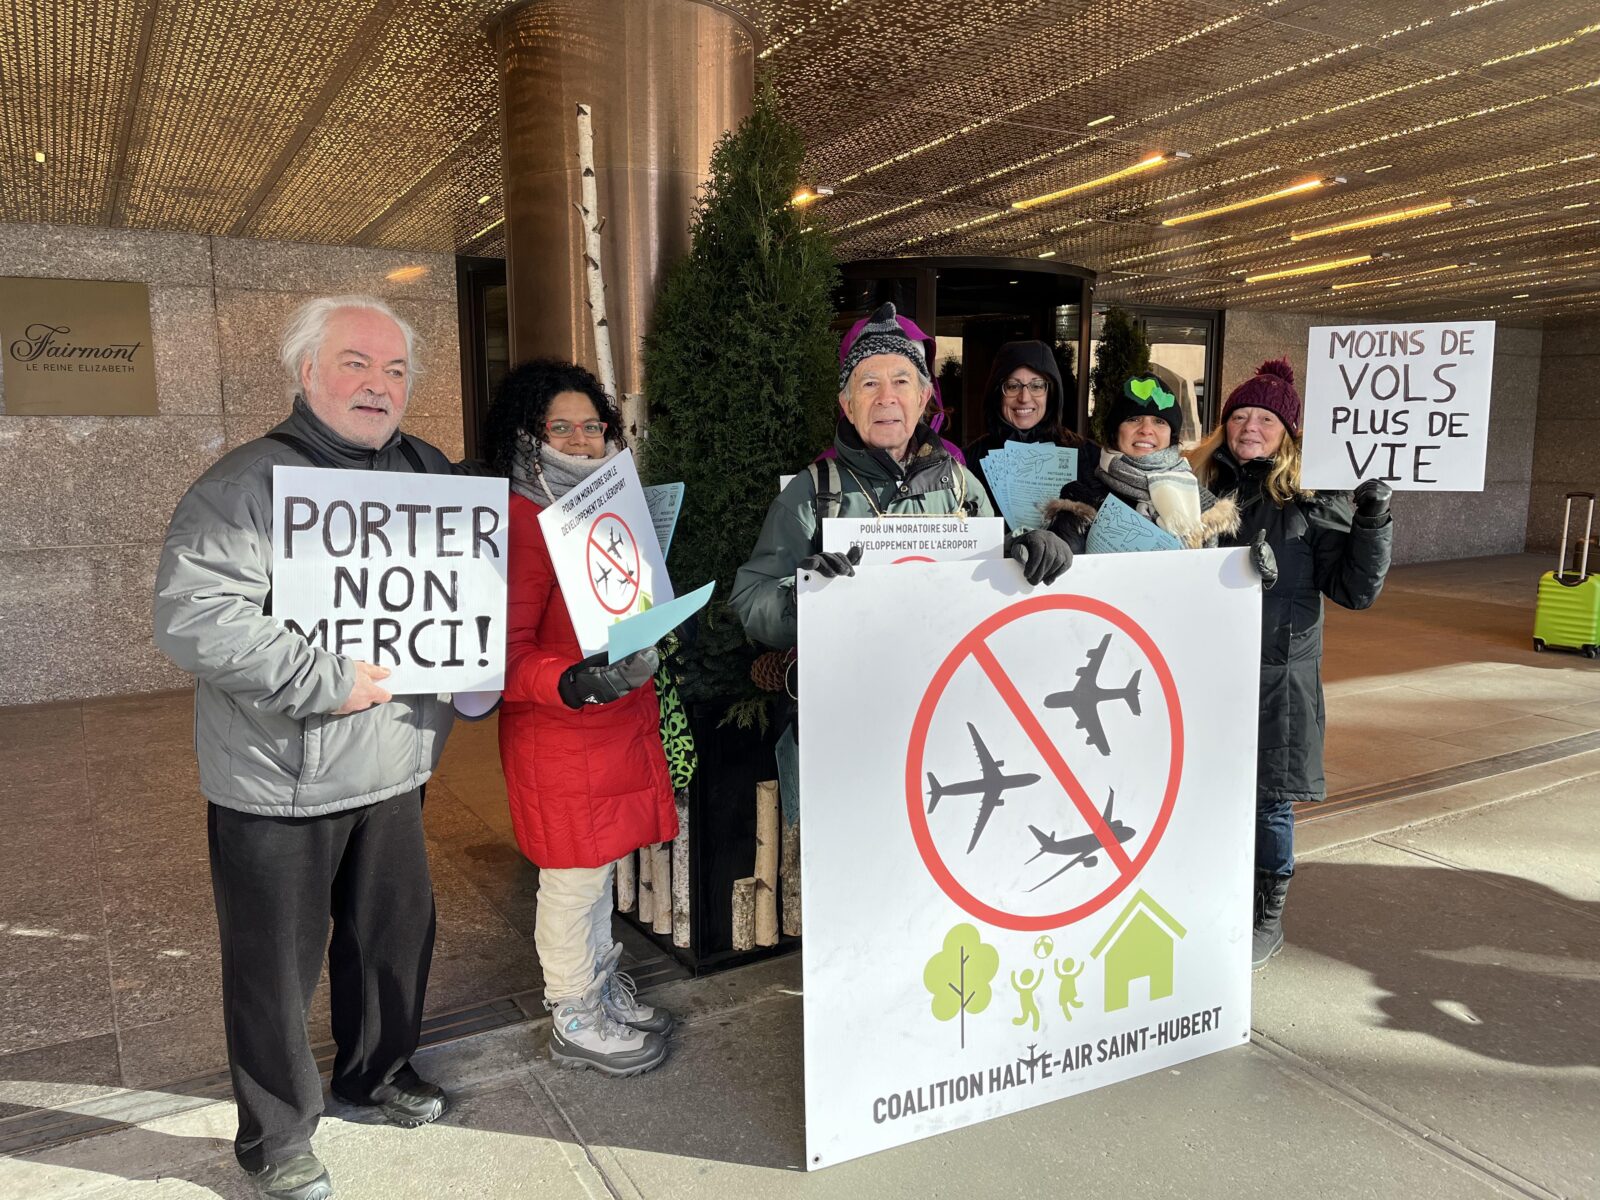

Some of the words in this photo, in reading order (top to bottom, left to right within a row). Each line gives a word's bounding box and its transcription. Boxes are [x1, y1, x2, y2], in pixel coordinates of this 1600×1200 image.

[10, 323, 144, 362] Fairmont
[1329, 329, 1426, 360] MOINS
[1440, 329, 1475, 356] DE
[26, 363, 39, 371] LE
[43, 363, 73, 372] REINE
[78, 364, 135, 373] ELIZABETH
[1338, 363, 1457, 403] VOLS
[1331, 406, 1410, 436] PLUS
[1428, 411, 1470, 438] DE
[1346, 441, 1441, 484] VIE
[562, 499, 576, 515] POUR
[573, 494, 582, 506] UN
[580, 475, 605, 501] MORATOIRE
[602, 469, 613, 483] SUR
[610, 465, 618, 477] LE
[596, 496, 605, 508] DE
[284, 496, 500, 559] PORTER
[860, 524, 881, 534] POUR
[882, 524, 894, 534] UN
[895, 523, 941, 534] MORATOIRE
[942, 523, 958, 533] SUR
[959, 523, 969, 533] LE
[919, 541, 930, 550] DE
[931, 538, 978, 550] L'AÉROPORT
[333, 565, 458, 613] NON
[873, 1071, 983, 1124] COALITION
[1096, 1006, 1223, 1063] SAINT-HUBERT
